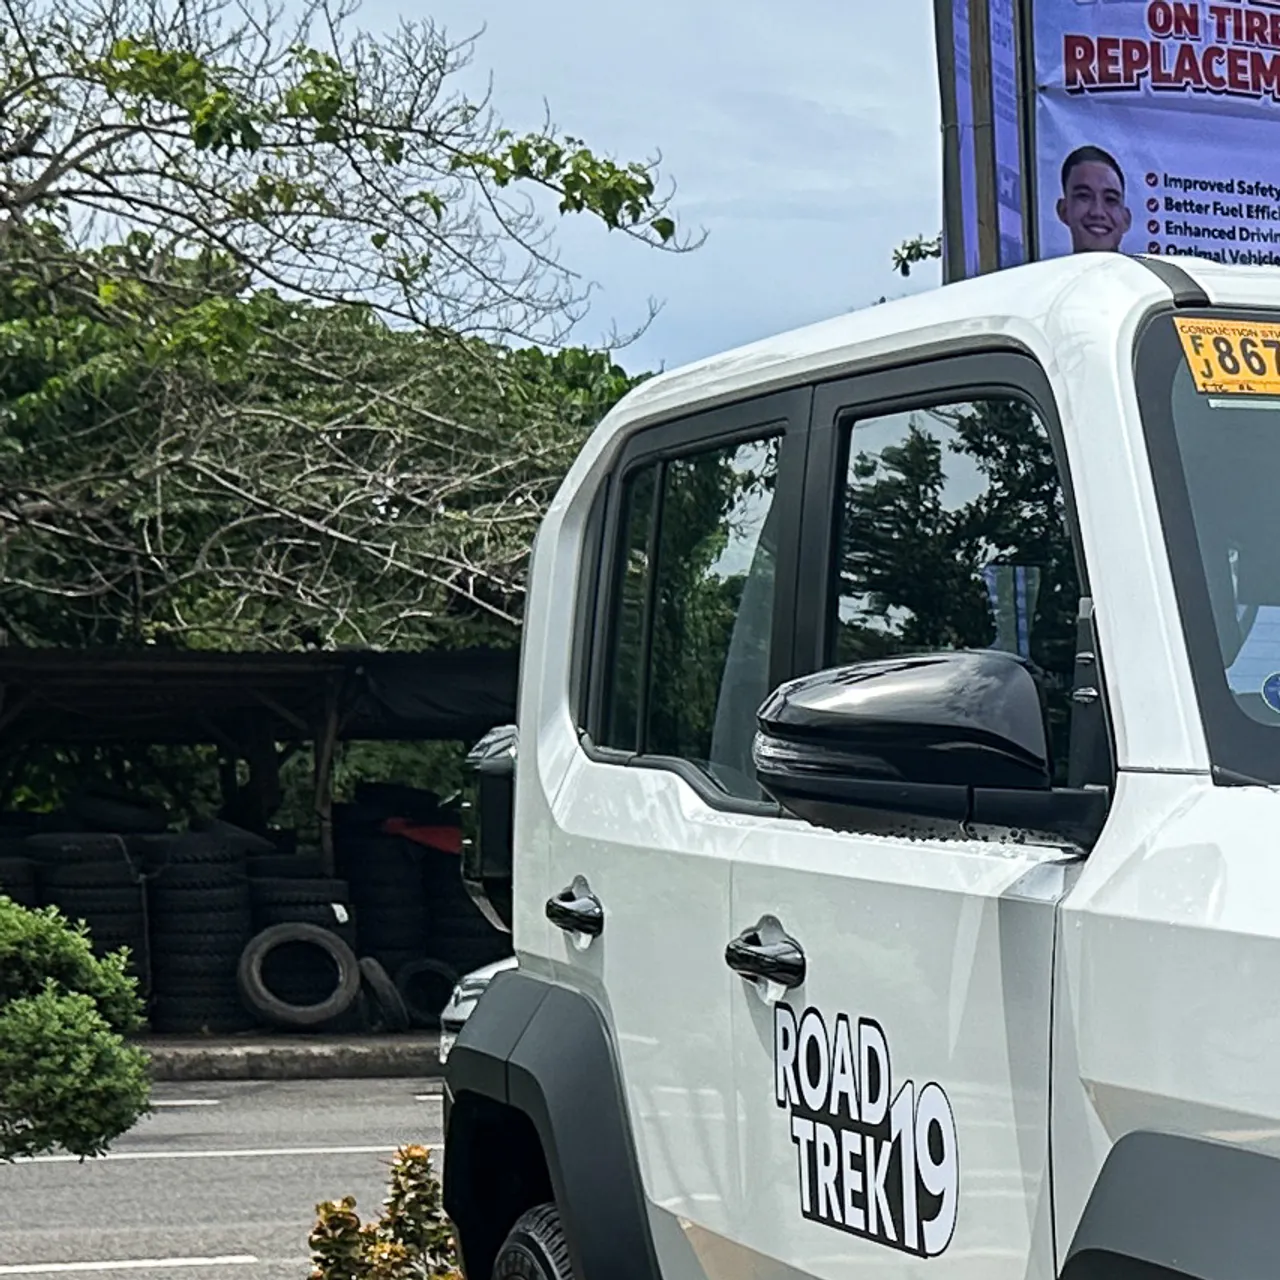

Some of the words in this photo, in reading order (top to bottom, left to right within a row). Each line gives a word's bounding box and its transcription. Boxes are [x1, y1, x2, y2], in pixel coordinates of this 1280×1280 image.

[1148, 3, 1200, 39] ON
[1163, 173, 1234, 193] Improved
[1164, 197, 1211, 215] Better
[1213, 201, 1244, 218] Fuel
[1165, 221, 1236, 240] Enhanced
[1180, 325, 1258, 338] CONDUCTION
[1190, 335, 1205, 357] F
[1200, 358, 1213, 379] J
[775, 1002, 891, 1125] ROAD
